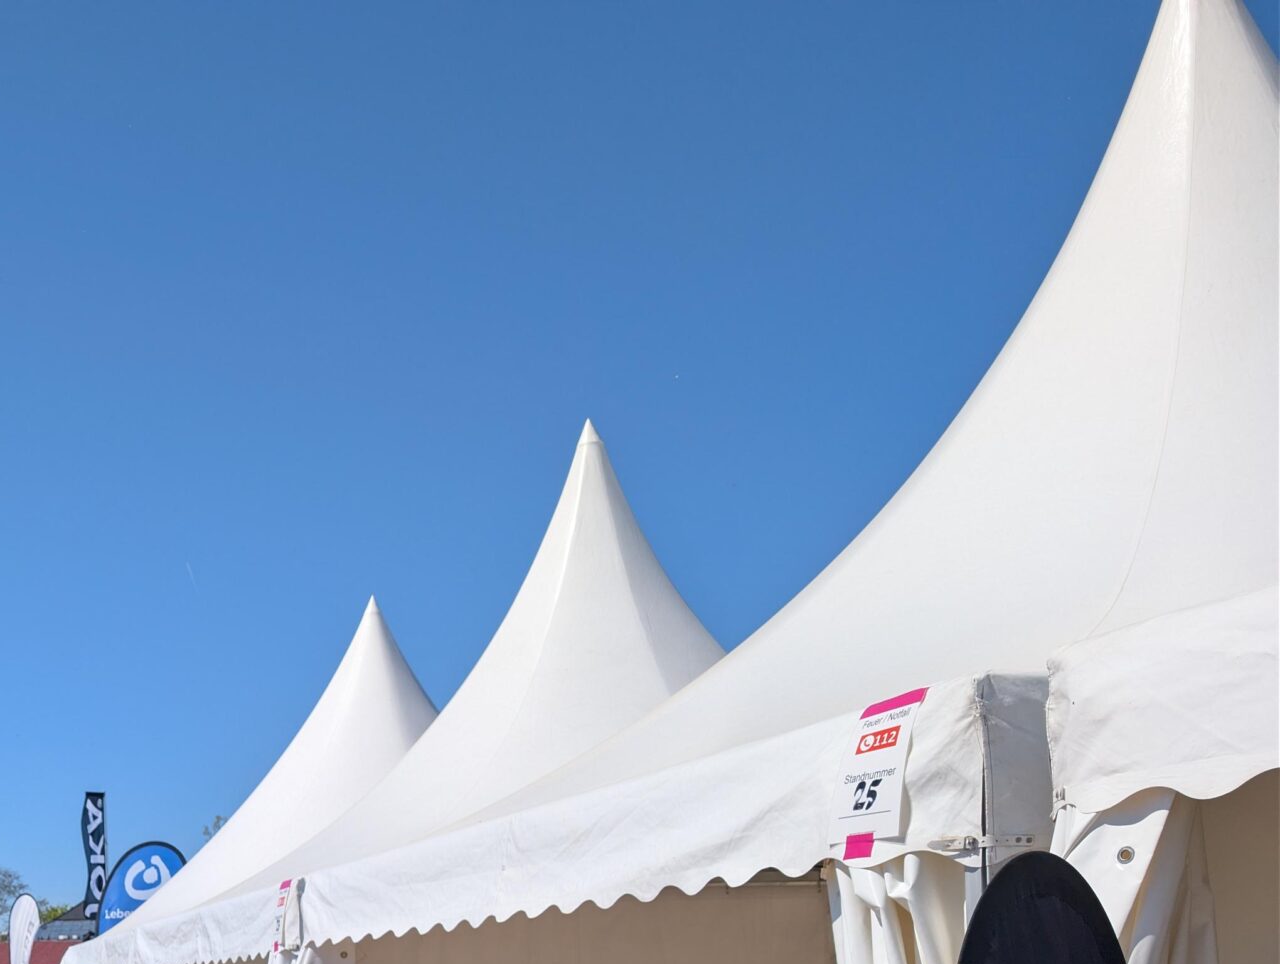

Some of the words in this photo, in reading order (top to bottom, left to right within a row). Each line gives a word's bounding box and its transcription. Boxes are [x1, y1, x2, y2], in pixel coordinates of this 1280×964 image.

[862, 714, 882, 729] Feuer
[888, 706, 912, 722] Notfall
[873, 730, 896, 747] 112
[844, 767, 896, 785] Standnummer
[852, 778, 882, 811] 25
